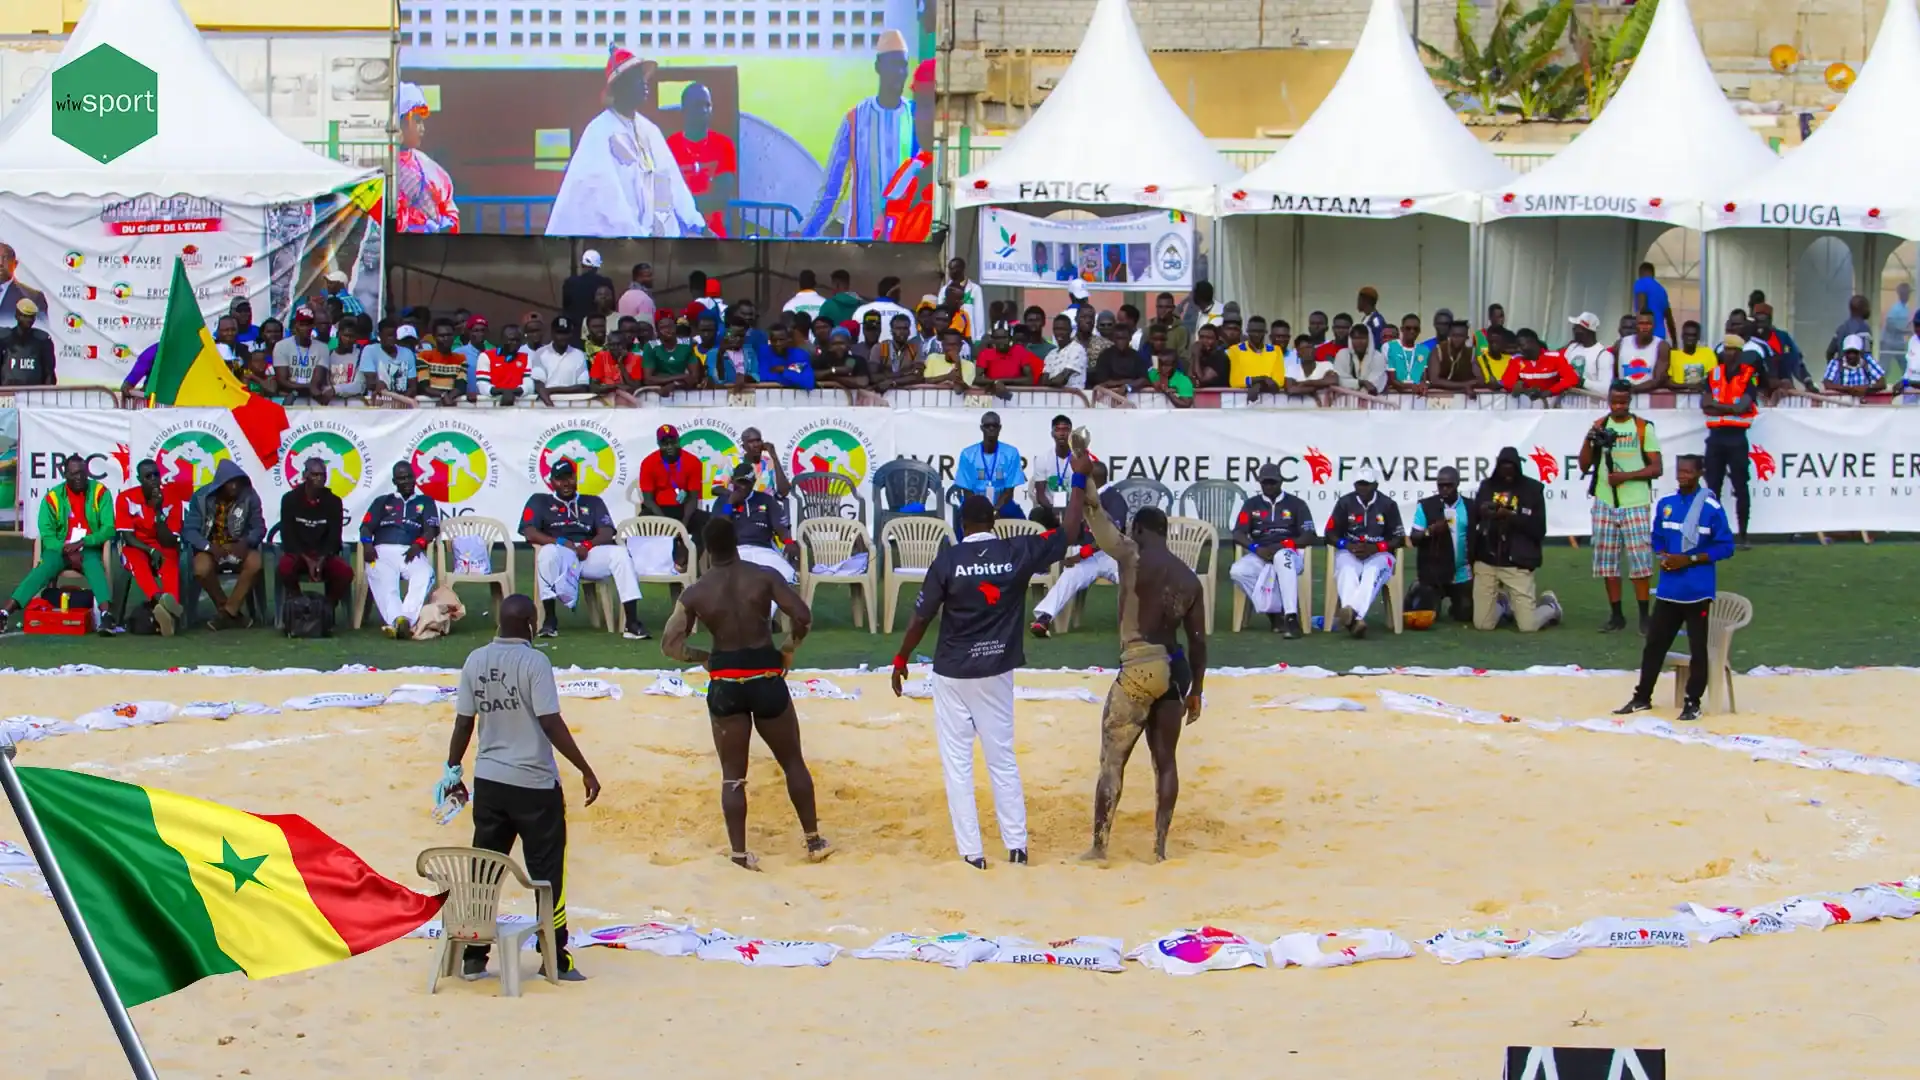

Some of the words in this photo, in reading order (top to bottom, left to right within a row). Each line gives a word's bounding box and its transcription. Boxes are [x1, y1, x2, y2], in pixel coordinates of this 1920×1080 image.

[1019, 181, 1111, 202] FATICK
[1271, 194, 1372, 215] MATAM
[1524, 194, 1637, 213] SAINT-LOUIS
[1760, 203, 1842, 227] LOUGA
[121, 225, 136, 234] DU
[137, 224, 161, 233] CHEF
[163, 223, 176, 232] DE
[98, 256, 121, 265] ERIC
[131, 256, 162, 265] FAVRE
[62, 285, 80, 293] ERIC
[147, 288, 169, 297] ERIC
[98, 317, 121, 326] ERIC
[129, 316, 163, 326] FAVRE
[150, 423, 182, 452] NATIONAL
[184, 420, 194, 428] DE
[197, 420, 228, 440] GESTION
[278, 423, 312, 454] NATIONAL
[314, 420, 323, 428] DE
[327, 421, 360, 442] GESTION
[404, 423, 437, 454] NATIONAL
[439, 420, 449, 428] DE
[451, 420, 484, 441] GESTION
[533, 423, 566, 451] NATIONAL
[568, 419, 577, 427] DE
[580, 419, 613, 439] GESTION
[706, 418, 738, 438] GESTION
[786, 421, 820, 450] NATIONAL
[820, 418, 830, 426] DE
[832, 419, 864, 438] GESTION
[31, 452, 109, 480] ERC
[1109, 456, 1210, 482] FAVRE
[1227, 456, 1300, 482] ERC
[1339, 456, 1438, 482] FAVRE
[1783, 453, 1876, 478] FAVRE
[1803, 486, 1876, 497] EXPERT
[954, 562, 1013, 577] Arbitre
[480, 698, 521, 713] OACH
[1611, 931, 1637, 941] ERIC
[1651, 930, 1685, 941] FAVRE
[1013, 953, 1044, 964] ERIC
[1058, 955, 1100, 966] FAVRE
